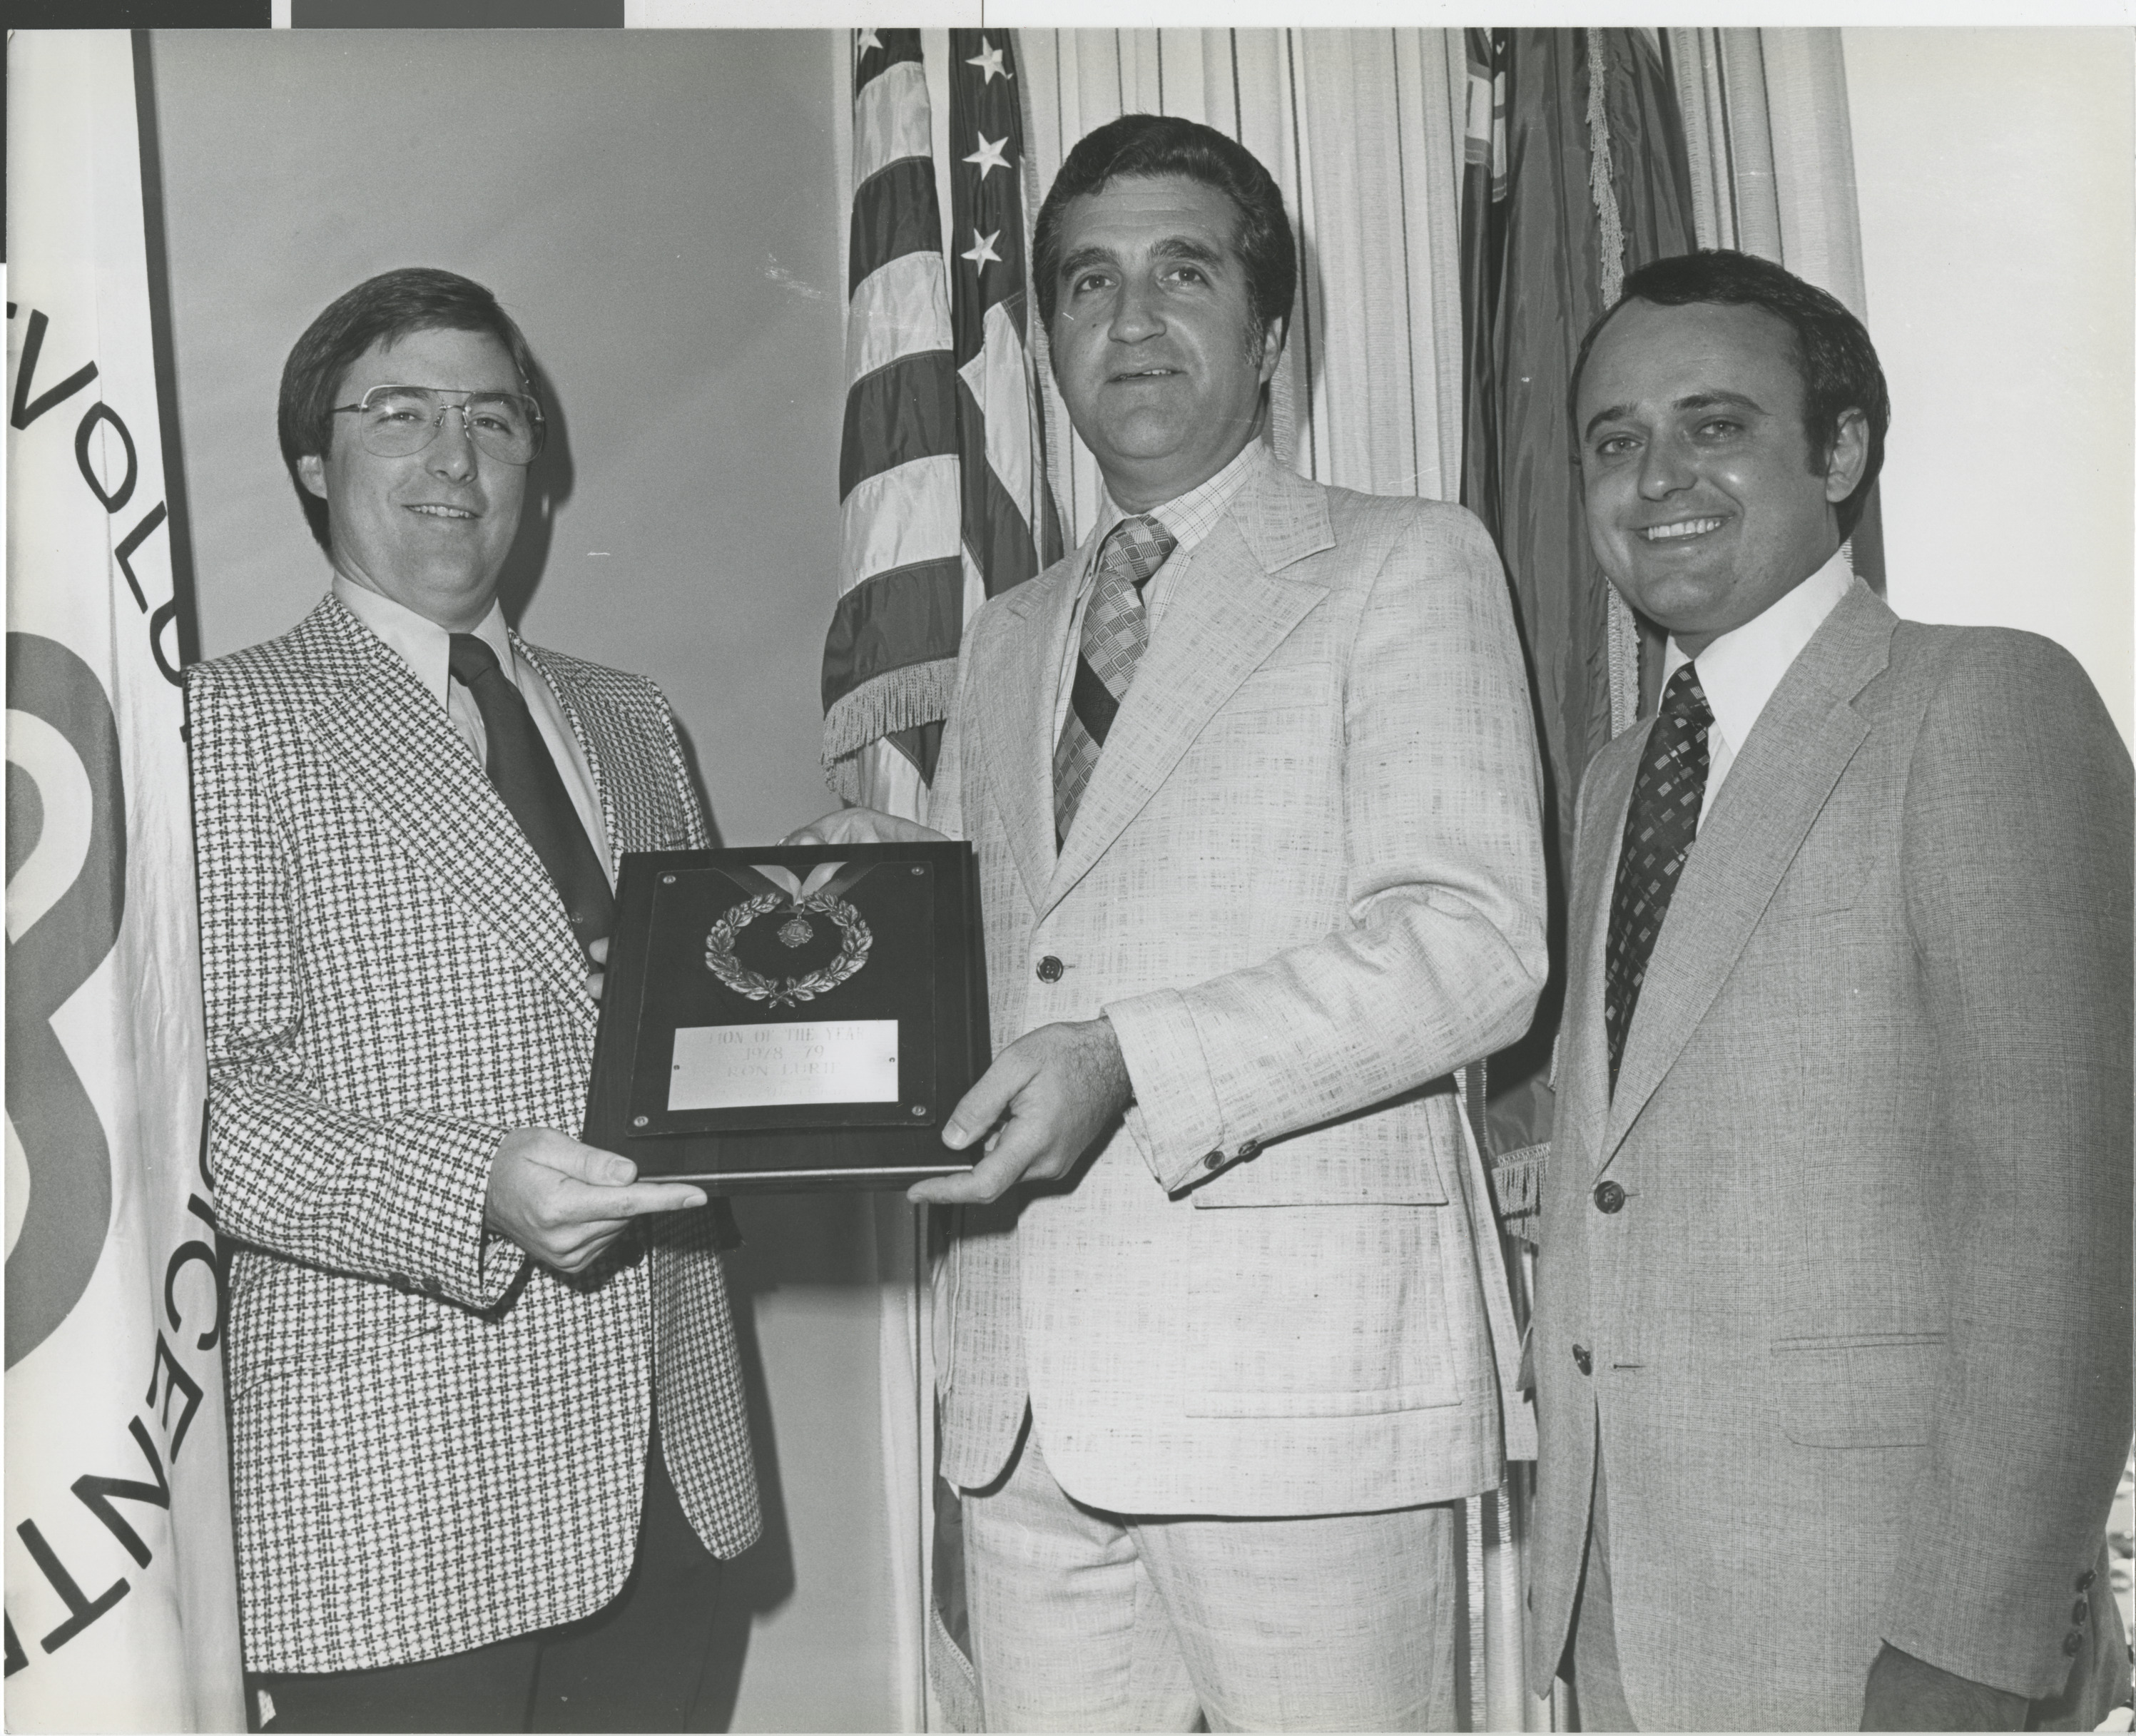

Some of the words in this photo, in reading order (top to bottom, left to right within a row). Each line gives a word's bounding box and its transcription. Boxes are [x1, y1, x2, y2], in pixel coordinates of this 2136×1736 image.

[785, 1027, 815, 1042] THE
[825, 1027, 864, 1041] YEAR
[727, 1065, 768, 1078] RON
